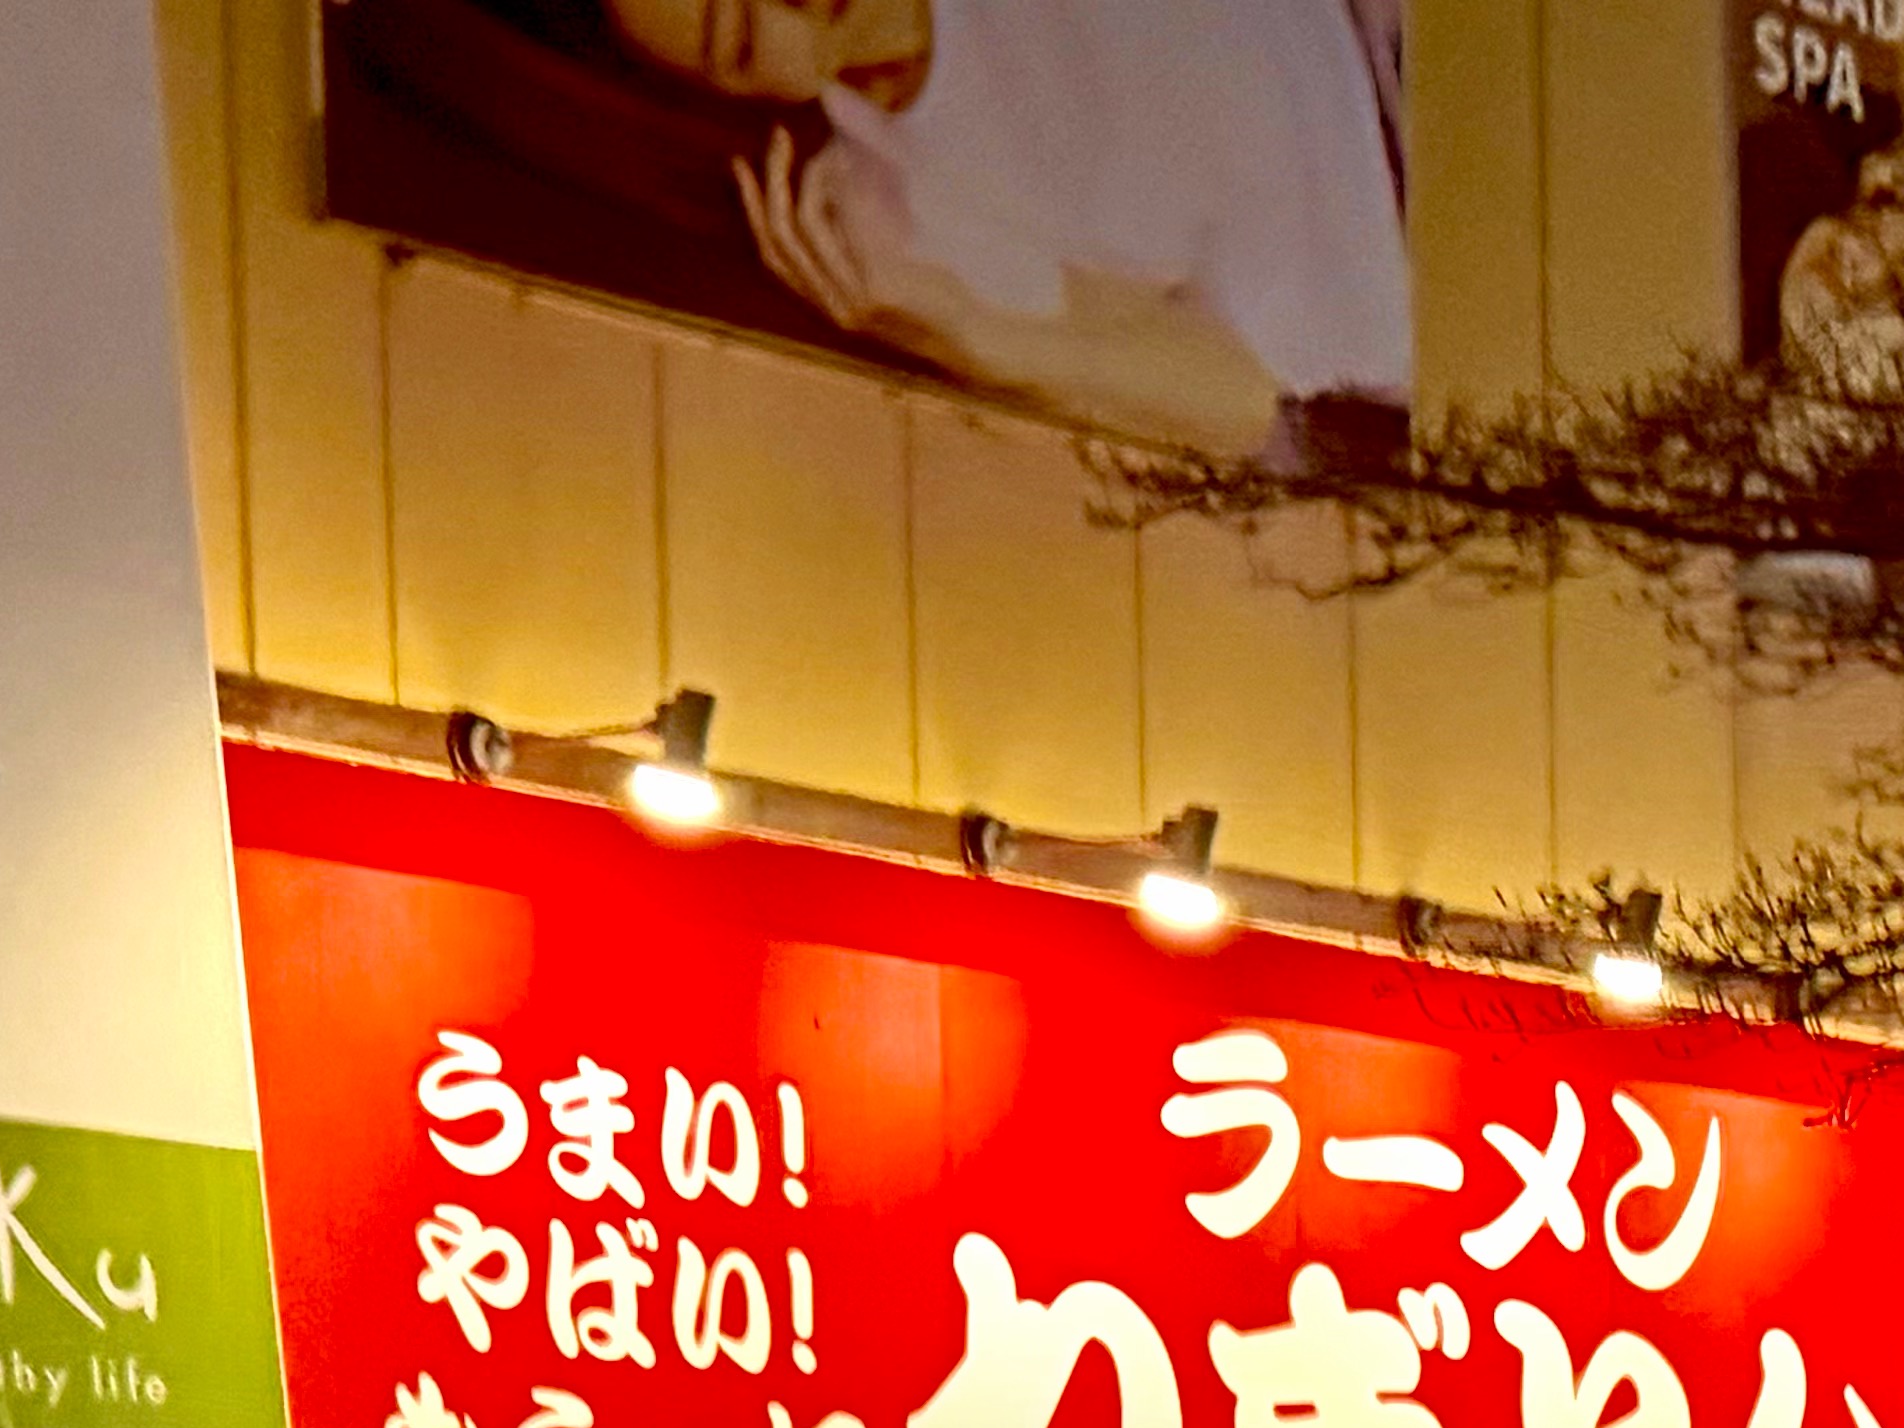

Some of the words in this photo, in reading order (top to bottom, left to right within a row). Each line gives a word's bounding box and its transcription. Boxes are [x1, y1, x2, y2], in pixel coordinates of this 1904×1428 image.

[1754, 13, 1865, 123] SPA
[1159, 1029, 1721, 1291] ラーメン
[91, 1356, 168, 1407] life
